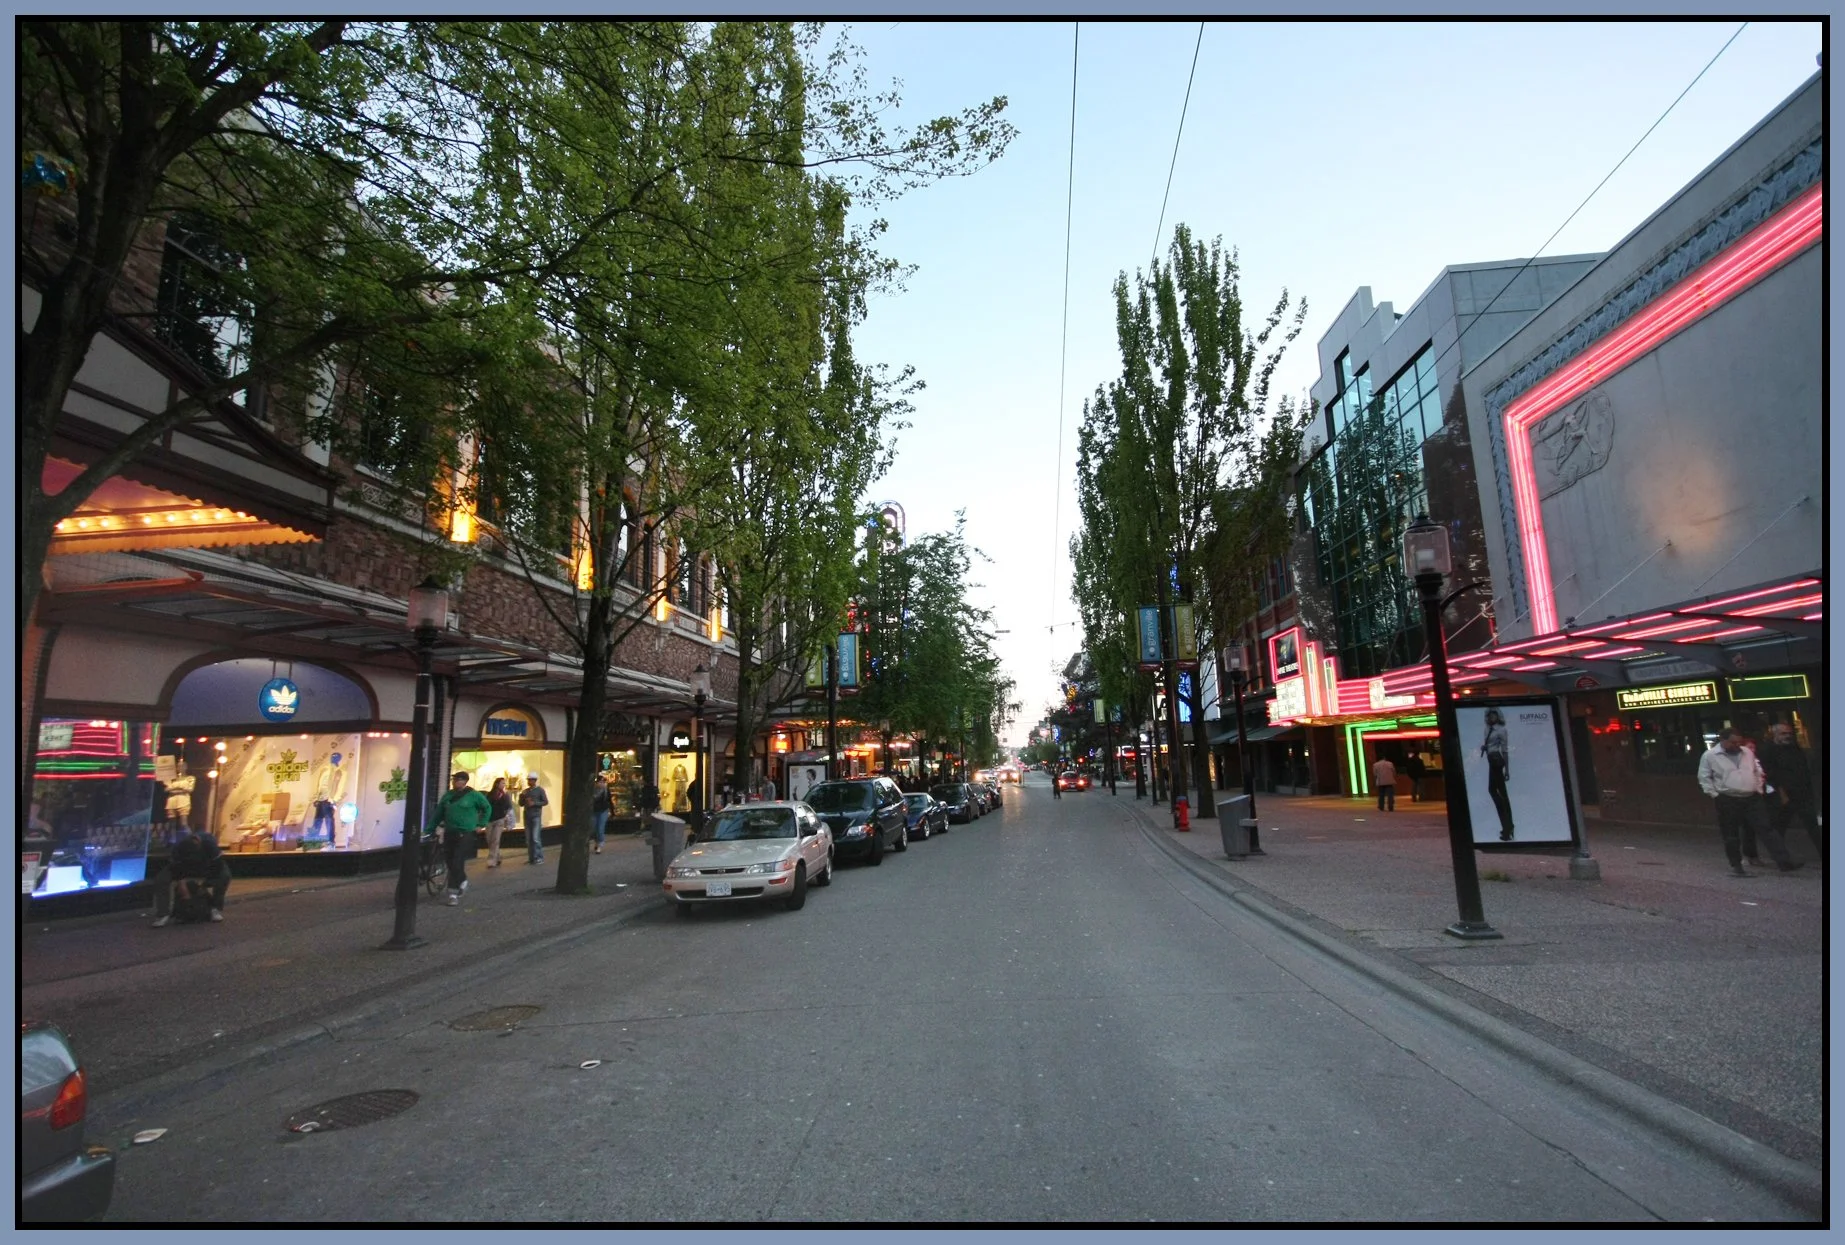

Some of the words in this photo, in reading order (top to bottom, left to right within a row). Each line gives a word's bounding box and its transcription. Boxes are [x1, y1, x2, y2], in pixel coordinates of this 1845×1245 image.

[1145, 609, 1157, 647] granville
[1623, 689, 1667, 703] GRANVILLE
[1667, 685, 1709, 699] CINEMAS
[268, 705, 295, 713] adidas
[266, 761, 309, 773] adidas
